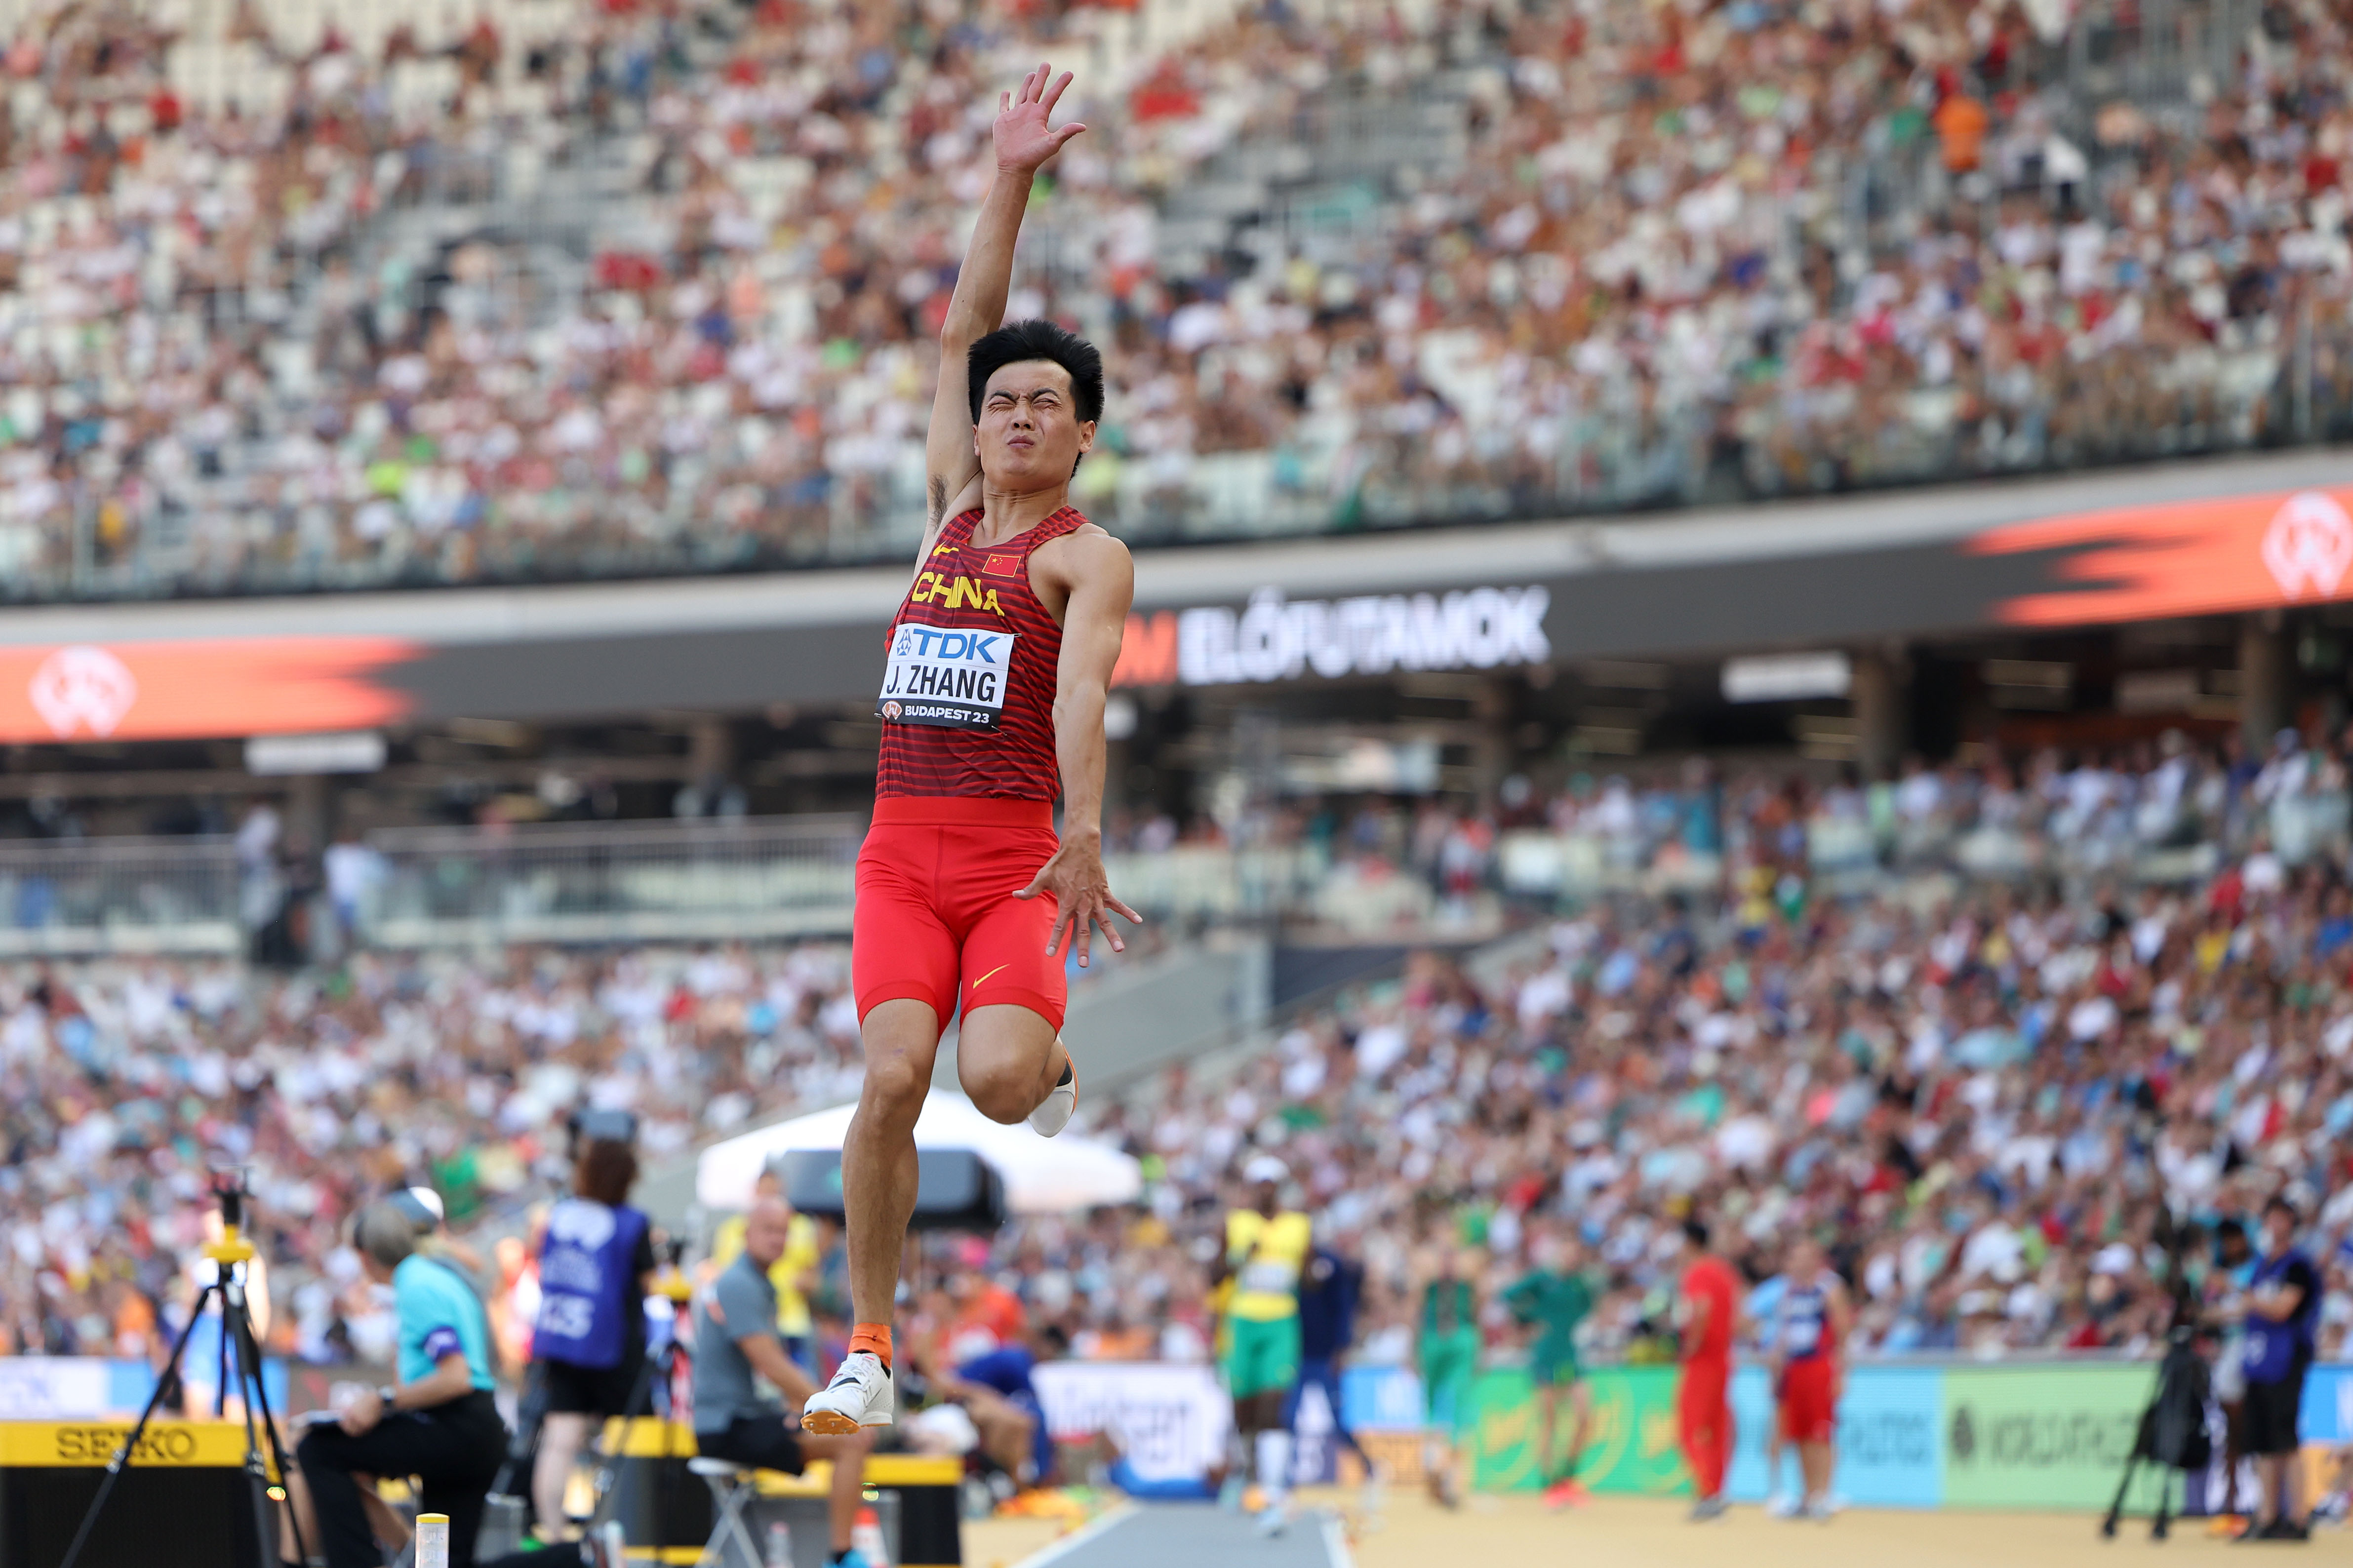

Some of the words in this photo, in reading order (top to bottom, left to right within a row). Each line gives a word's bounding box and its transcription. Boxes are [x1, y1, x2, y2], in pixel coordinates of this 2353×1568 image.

[911, 571, 1005, 617] CHINA
[914, 628, 1000, 664] TDK
[886, 665, 900, 694] J.
[906, 665, 996, 702] ZHANG
[905, 705, 972, 721] BUDAPEST
[972, 711, 990, 724] 23
[56, 1427, 197, 1459] SEKO
